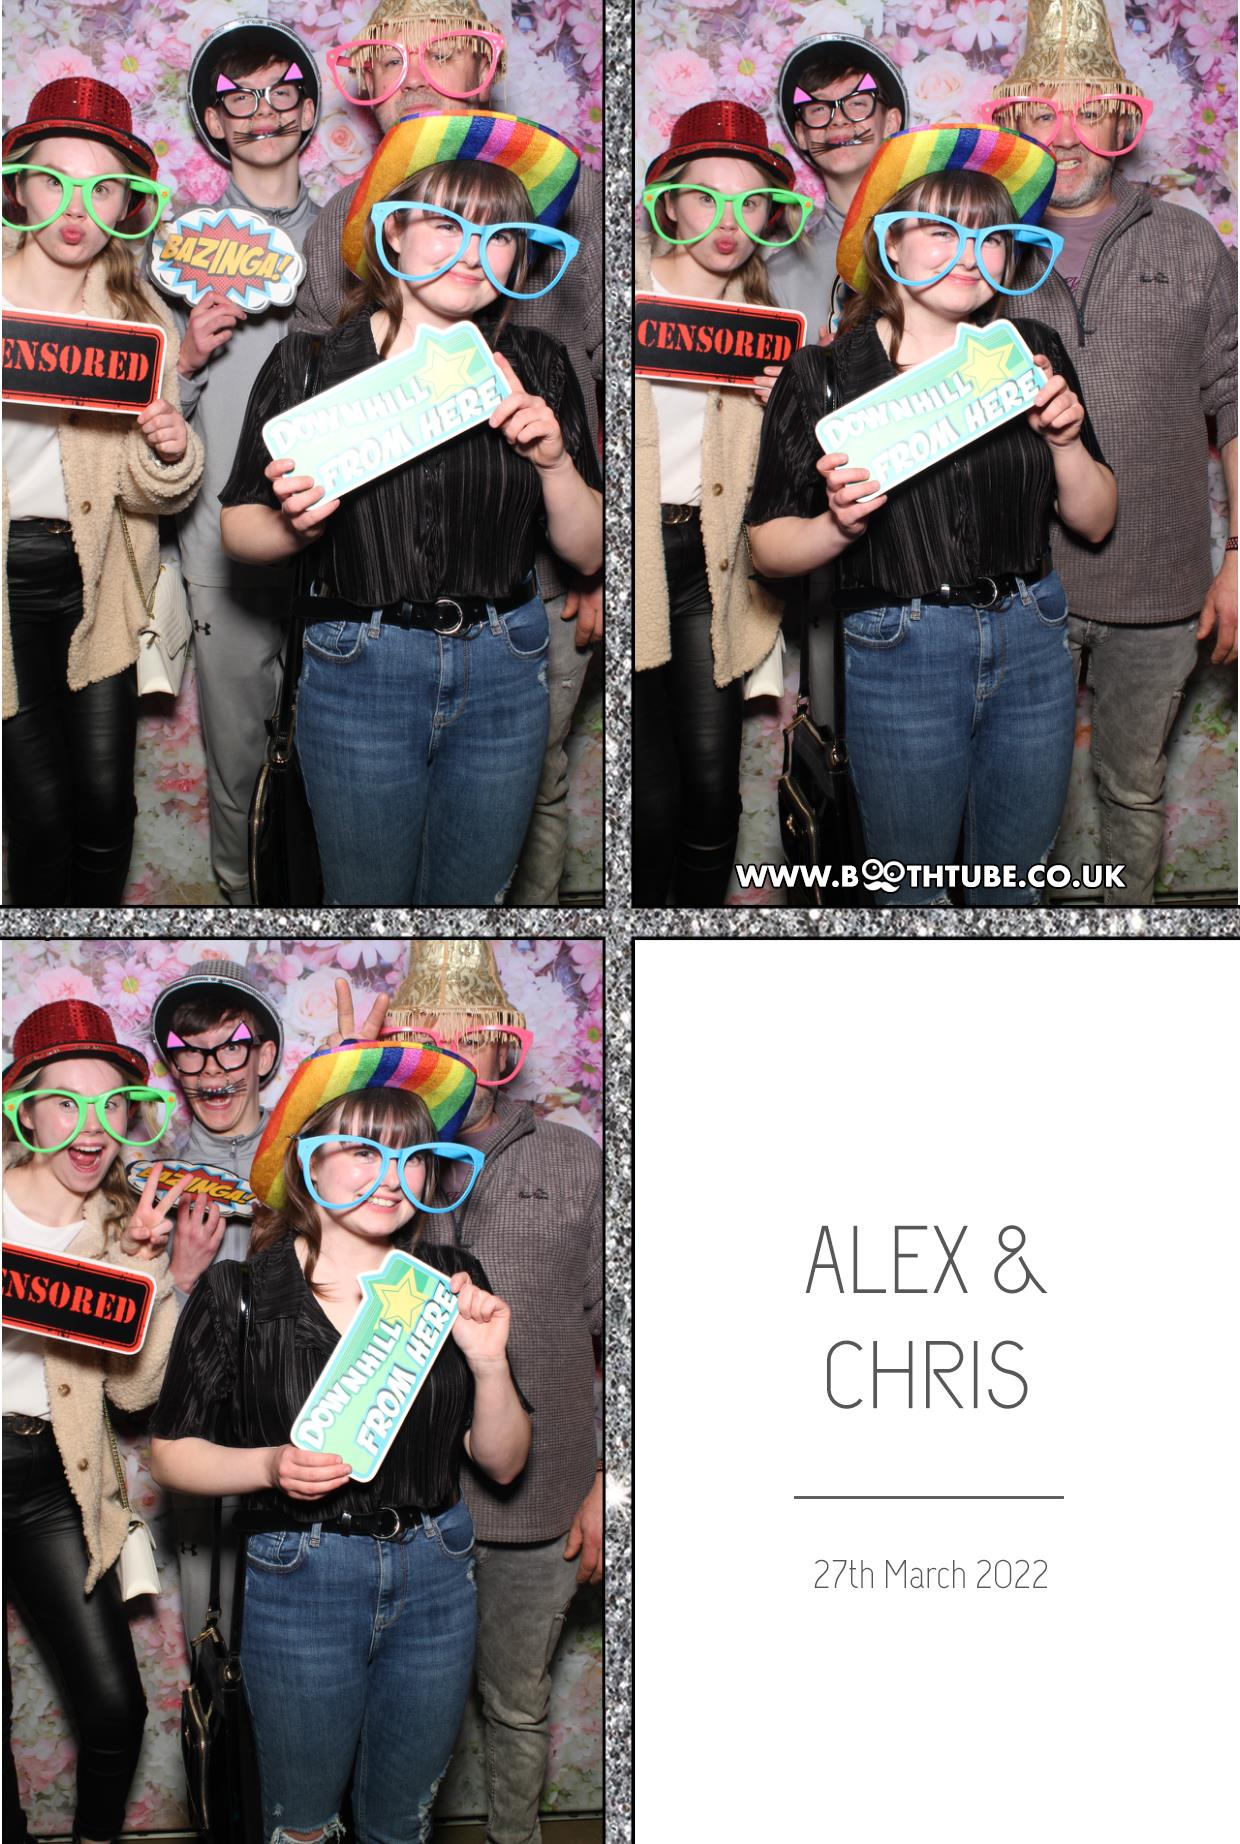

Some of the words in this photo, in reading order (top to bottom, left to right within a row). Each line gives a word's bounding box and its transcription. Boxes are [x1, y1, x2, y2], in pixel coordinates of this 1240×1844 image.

[160, 233, 294, 281] BAZINGA!
[636, 318, 793, 362] CENSORED
[271, 375, 434, 452] DOWNHILL
[317, 421, 415, 489] FROM
[418, 374, 504, 440] HERE
[822, 370, 975, 449] DOWNHILL
[871, 416, 961, 484] FROM
[964, 368, 1041, 433] HERE
[299, 1318, 403, 1451] DOWNHILL
[355, 1362, 417, 1457] FROM
[405, 1279, 458, 1367] HERE
